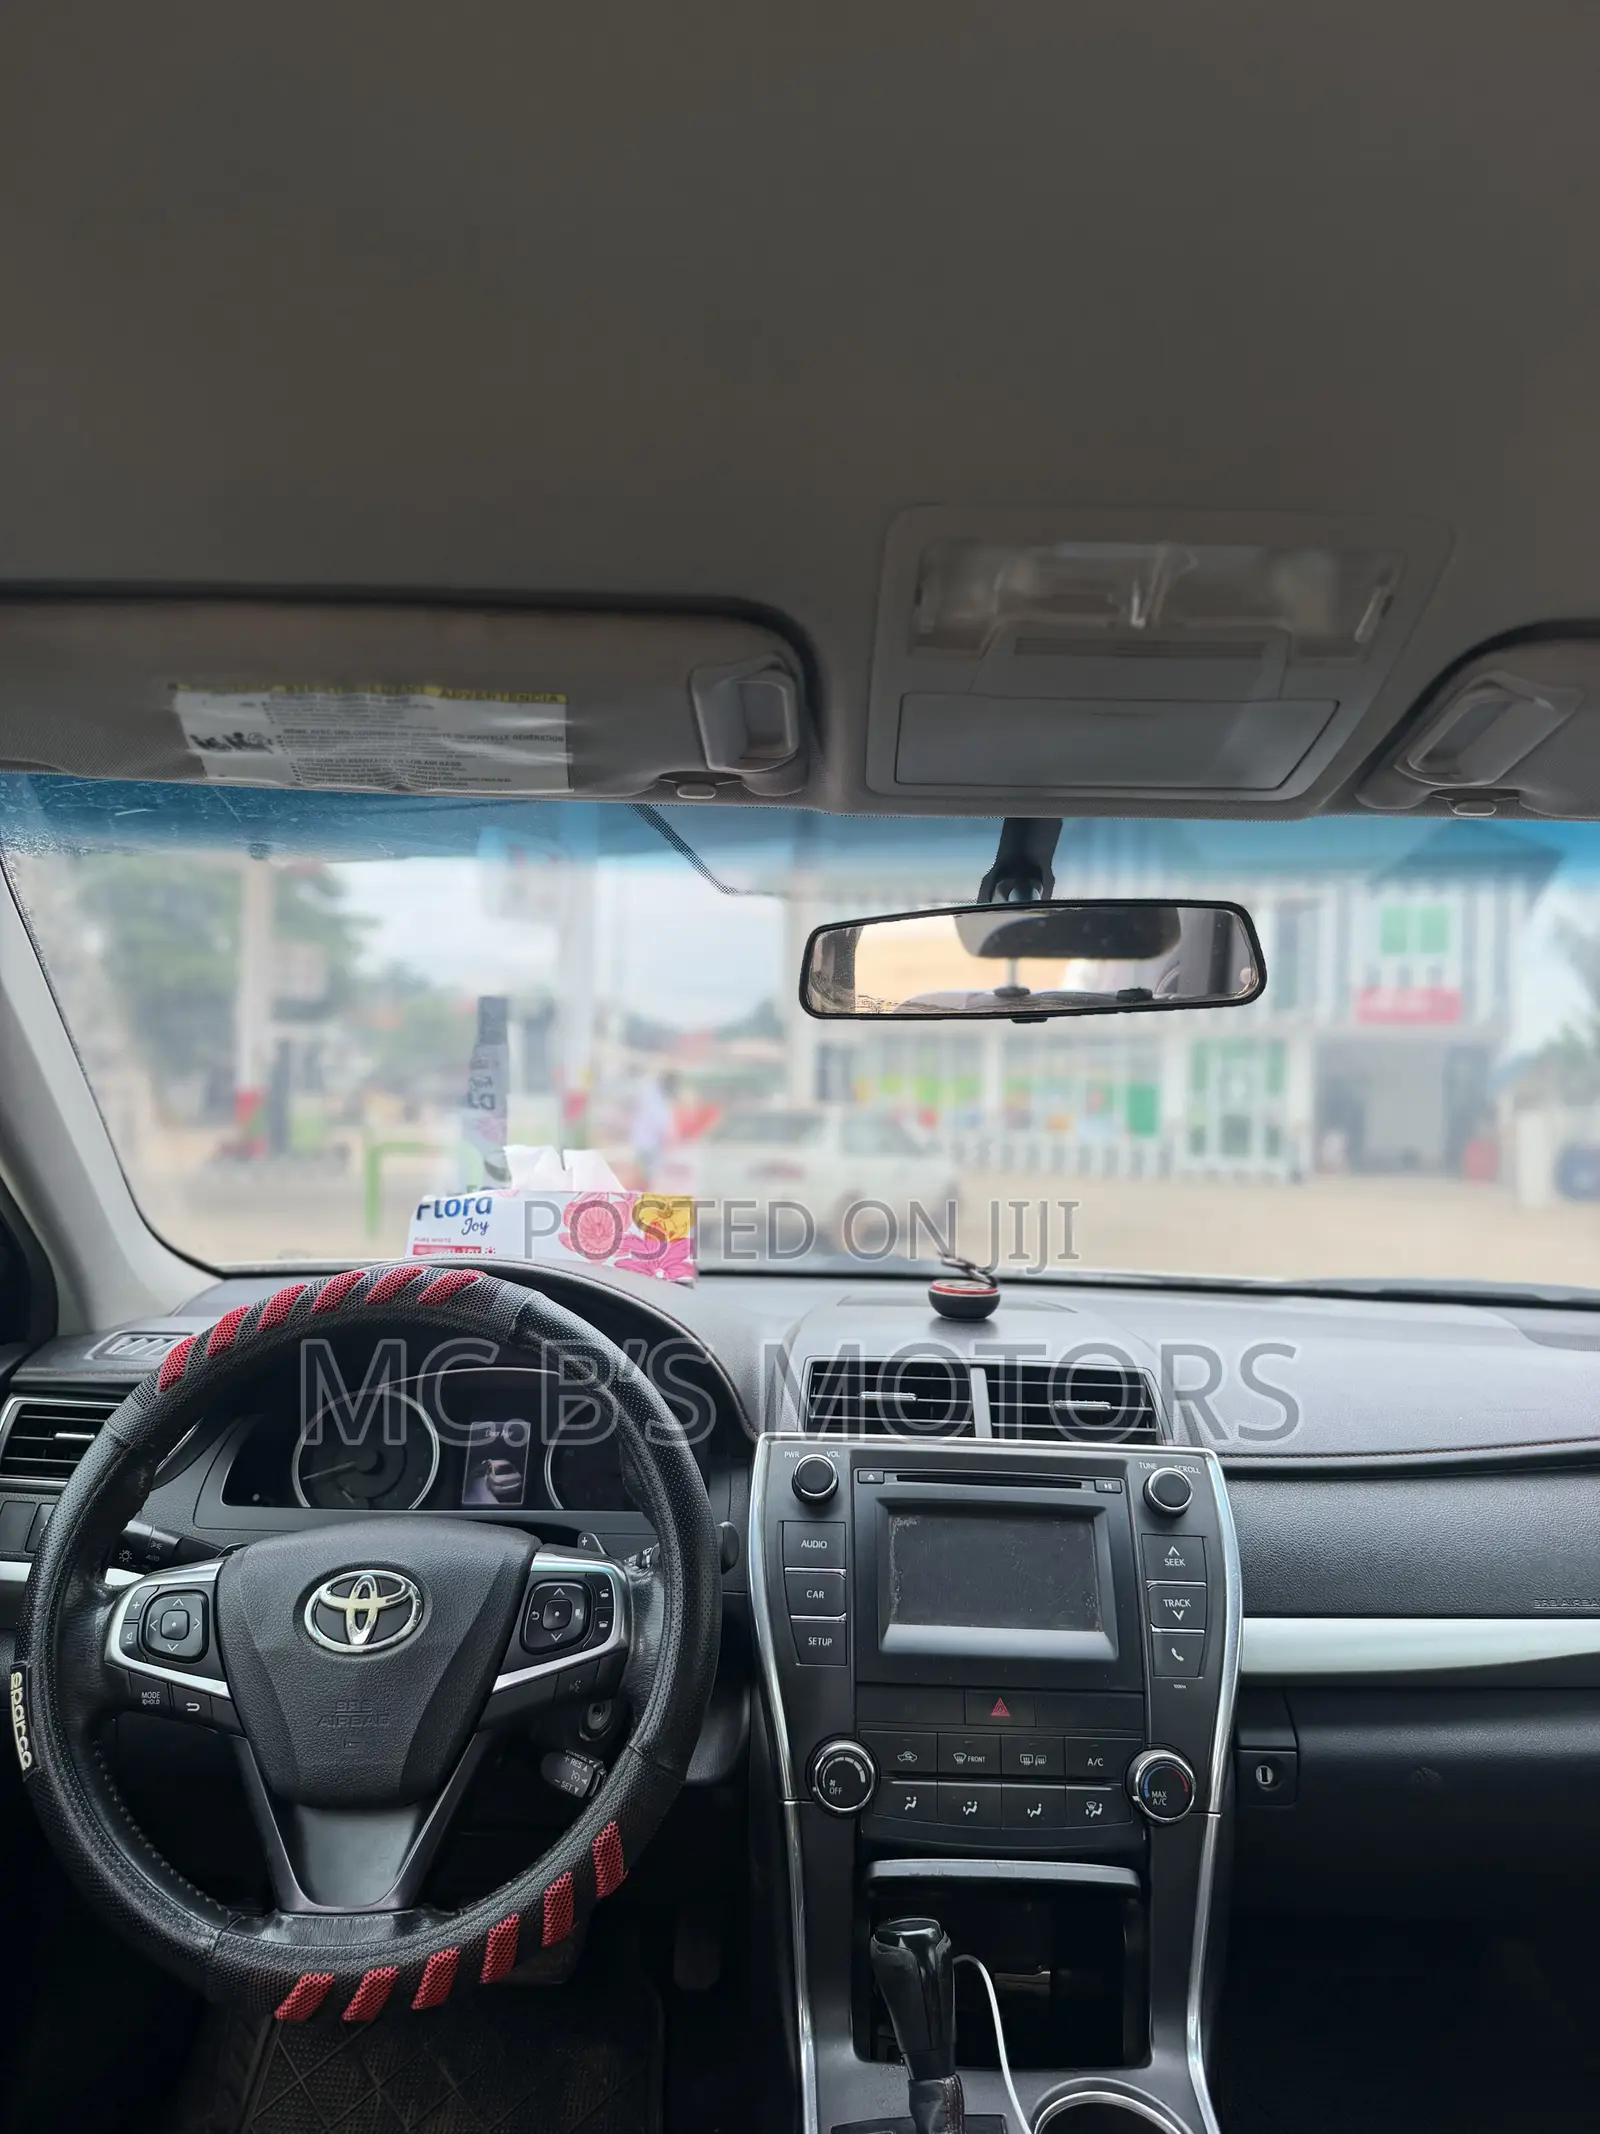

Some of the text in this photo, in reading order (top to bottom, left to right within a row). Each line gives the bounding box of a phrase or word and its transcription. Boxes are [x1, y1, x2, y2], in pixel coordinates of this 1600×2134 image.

[416, 1196, 493, 1220] Flora
[461, 1217, 489, 1235] Joy
[784, 1451, 800, 1459] PWR
[826, 1450, 840, 1458] VOL
[1138, 1461, 1157, 1470] TUNE
[1174, 1464, 1201, 1474] SCROLL
[801, 1540, 828, 1549] AUDIO
[1164, 1558, 1186, 1567] SEEK
[806, 1590, 825, 1599] CAR
[1163, 1599, 1191, 1608] TRACK
[808, 1636, 833, 1646] SETUP
[141, 1691, 161, 1699] MODE
[10, 1671, 33, 1771] sparco
[967, 1755, 986, 1763] FRONT
[1087, 1757, 1104, 1767] A/C
[829, 1786, 843, 1795] OFF
[1152, 1798, 1167, 1806] A/C
